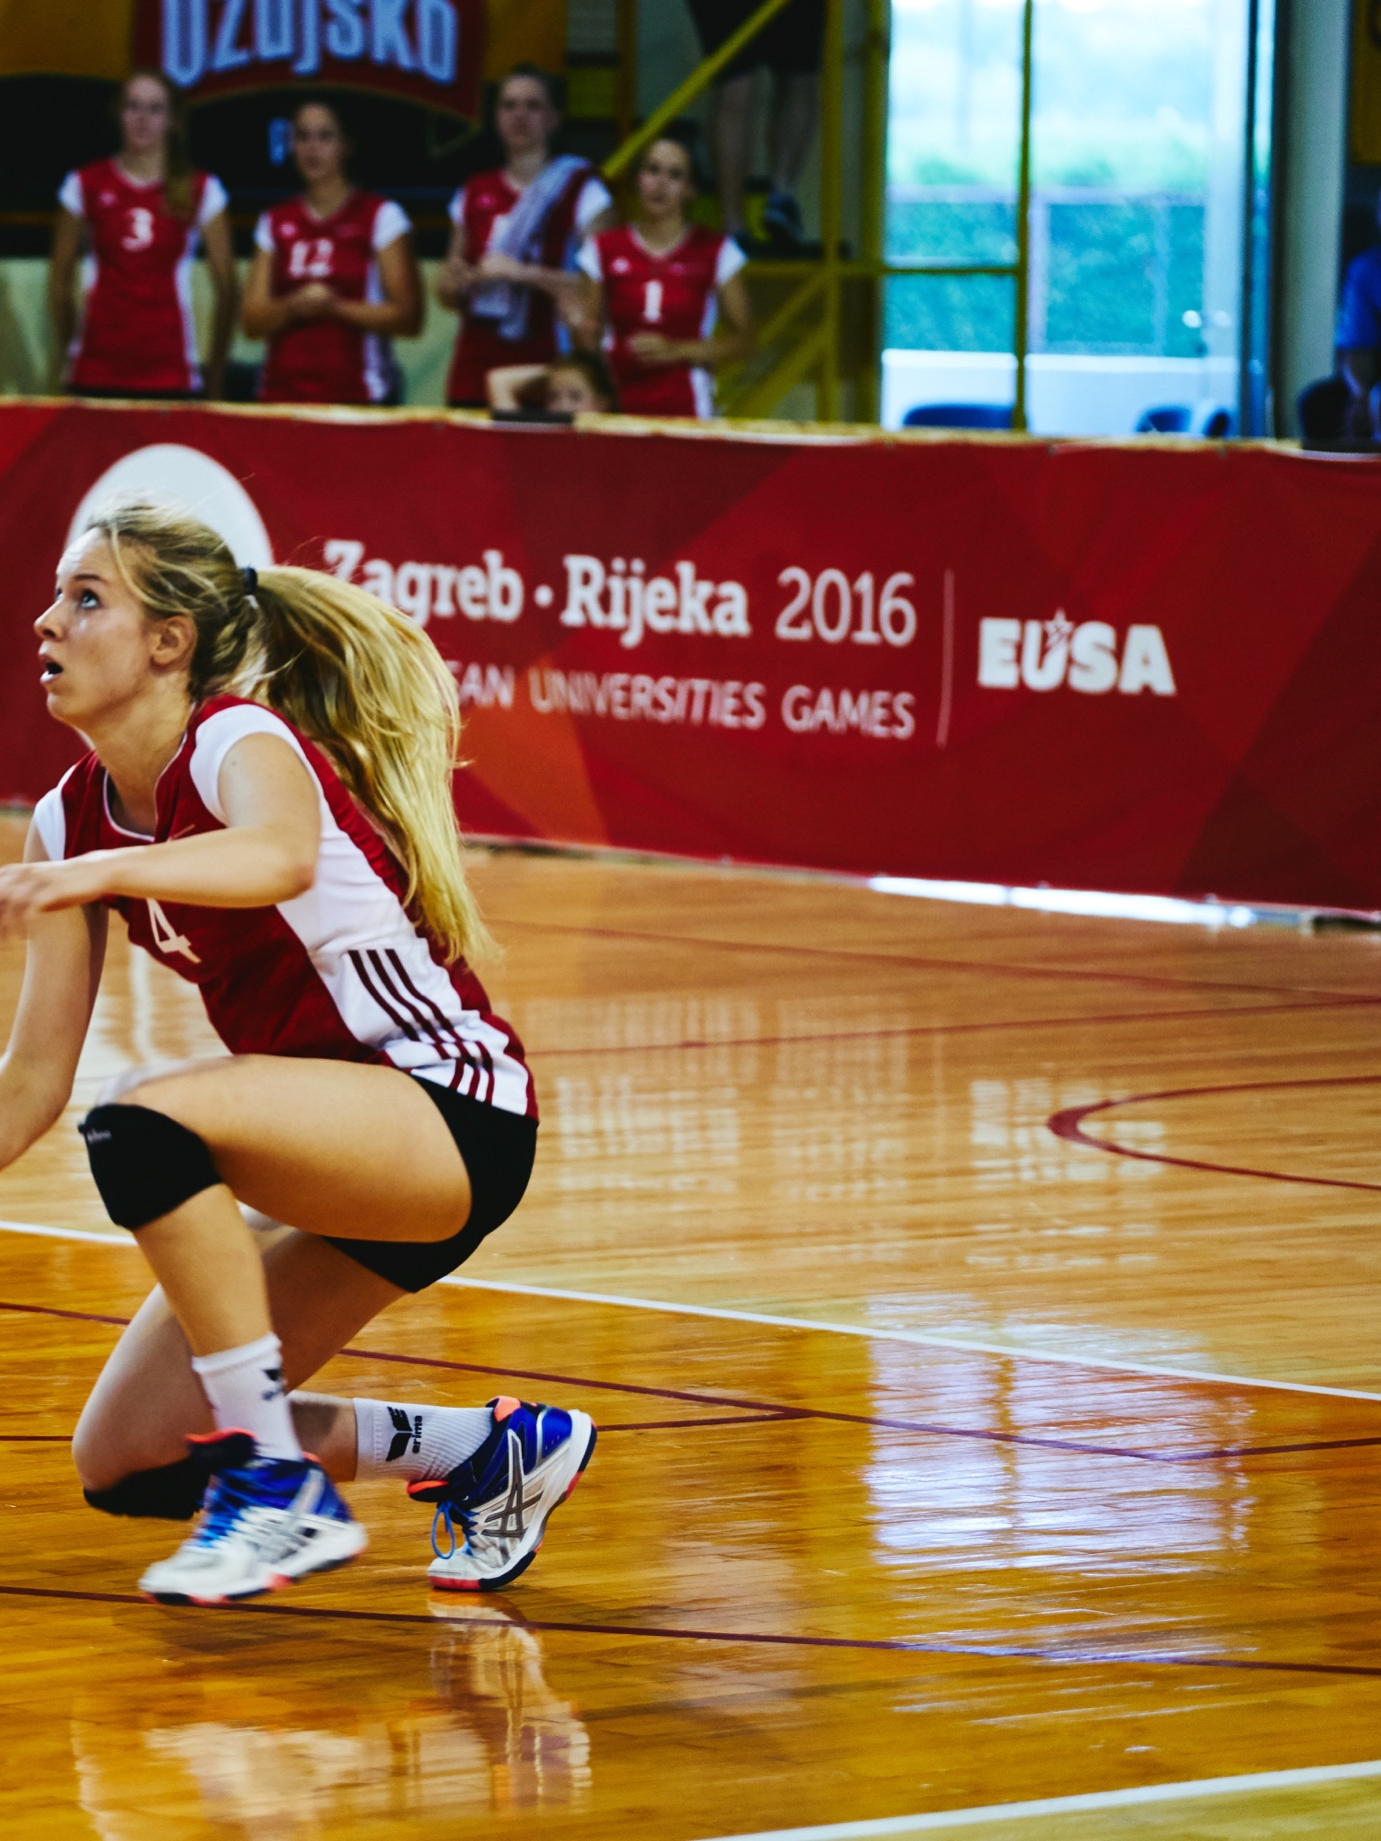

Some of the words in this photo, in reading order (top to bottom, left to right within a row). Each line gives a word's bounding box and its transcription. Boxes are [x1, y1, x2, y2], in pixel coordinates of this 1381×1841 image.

[122, 207, 154, 251] 3
[289, 237, 333, 277] 12
[643, 280, 663, 323] 1
[323, 540, 524, 629] Zagreb
[559, 554, 752, 648] Rijeka
[774, 566, 917, 647] 2016
[977, 615, 1177, 697] EUSA
[527, 667, 767, 731] UNIVERSITIES
[781, 684, 917, 740] GAMES
[145, 897, 201, 964] 4
